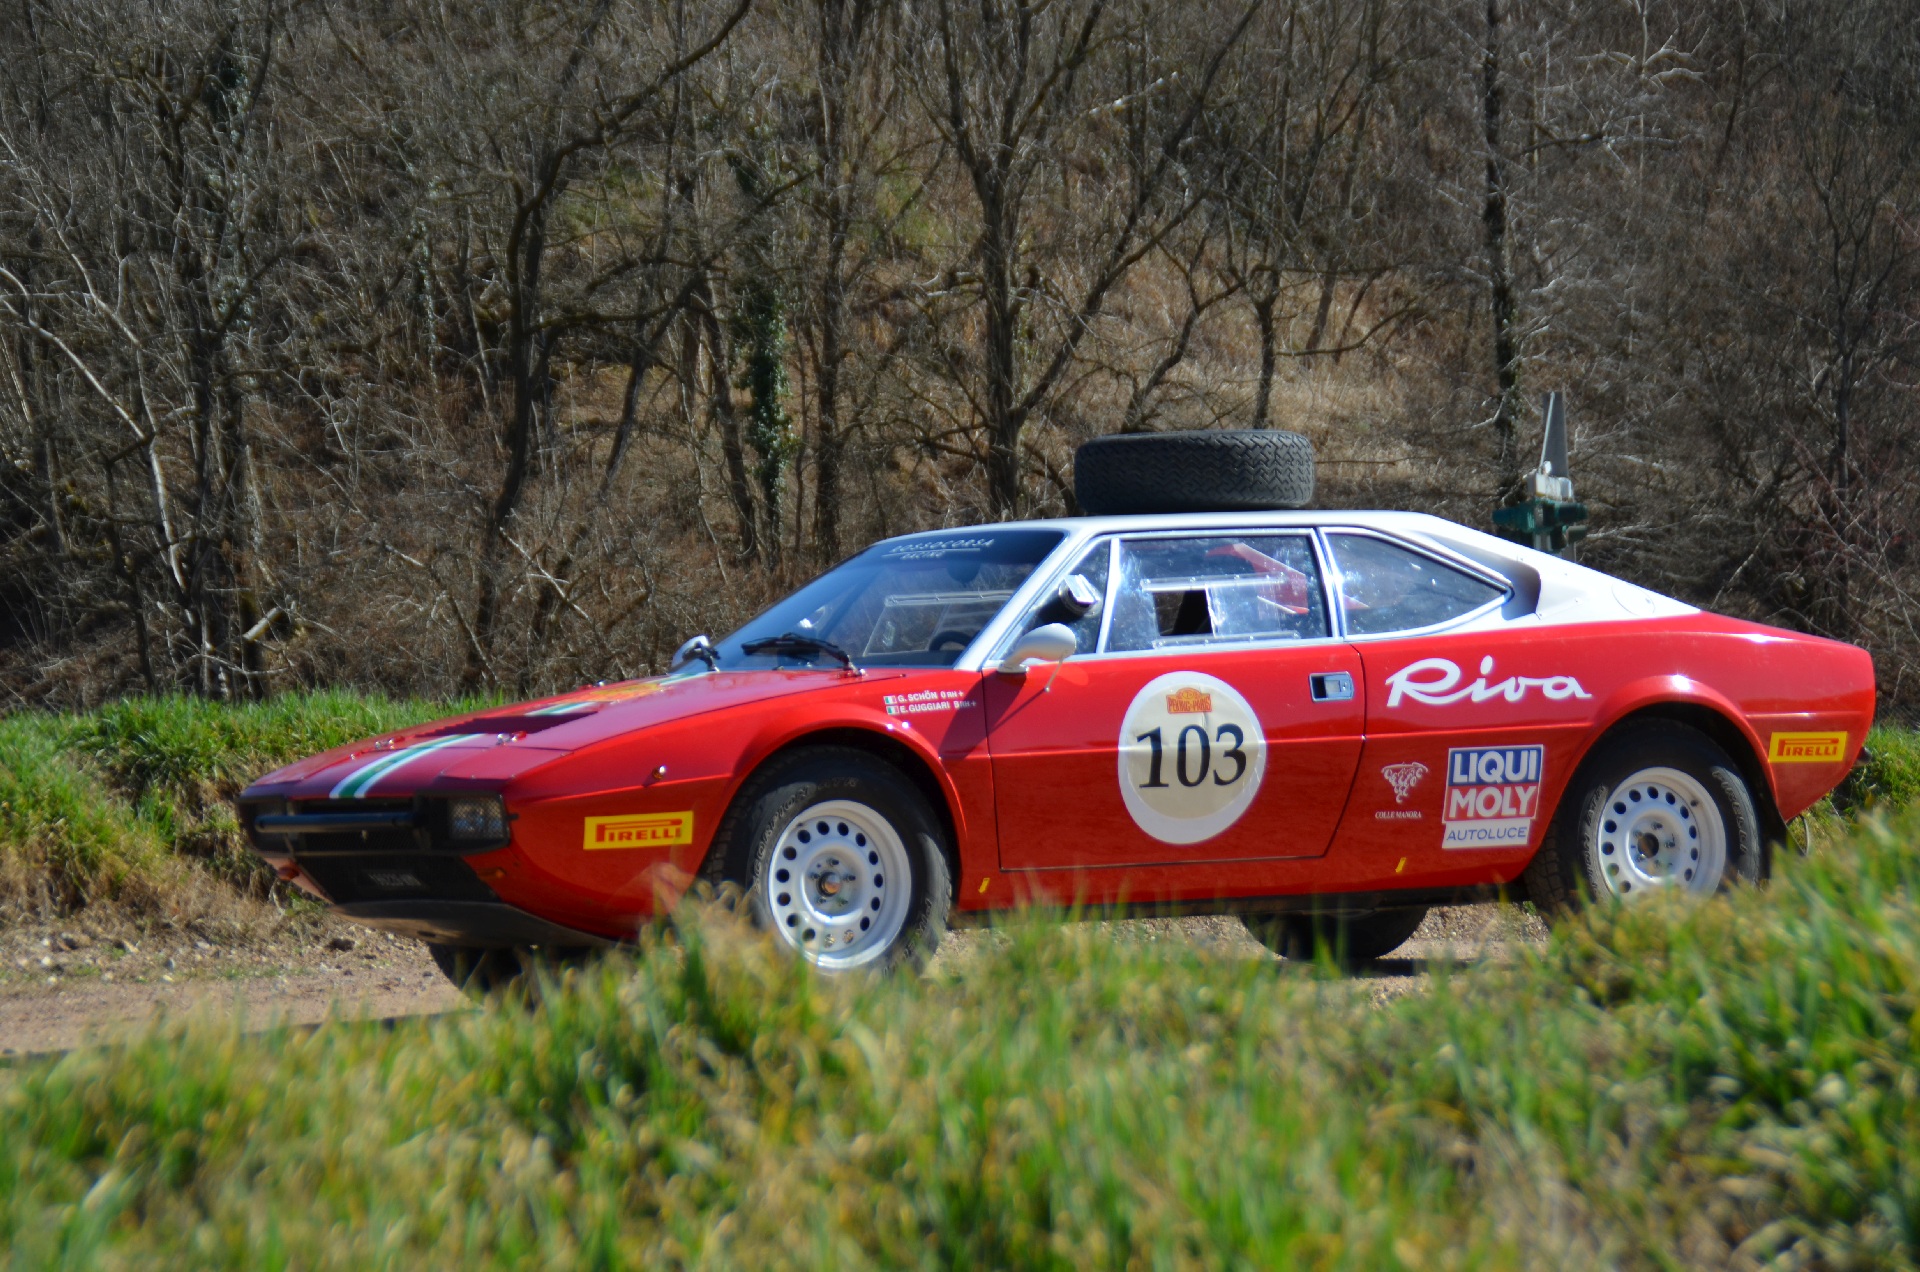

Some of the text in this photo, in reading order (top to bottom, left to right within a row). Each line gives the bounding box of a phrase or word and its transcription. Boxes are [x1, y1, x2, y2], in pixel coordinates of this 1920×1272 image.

[1385, 655, 1592, 706] Riva
[898, 693, 906, 702] G.
[907, 690, 938, 701] SCHÖN
[909, 701, 950, 712] GUGGIARI
[1136, 723, 1247, 788] 103
[1777, 738, 1839, 756] PIRELLI
[1453, 749, 1538, 784] LIQUI
[1449, 786, 1537, 818] MOLY
[1711, 770, 1748, 853] PIRELLI
[595, 819, 683, 842] PIRELLI
[1446, 827, 1527, 841] AUTOLUCE
